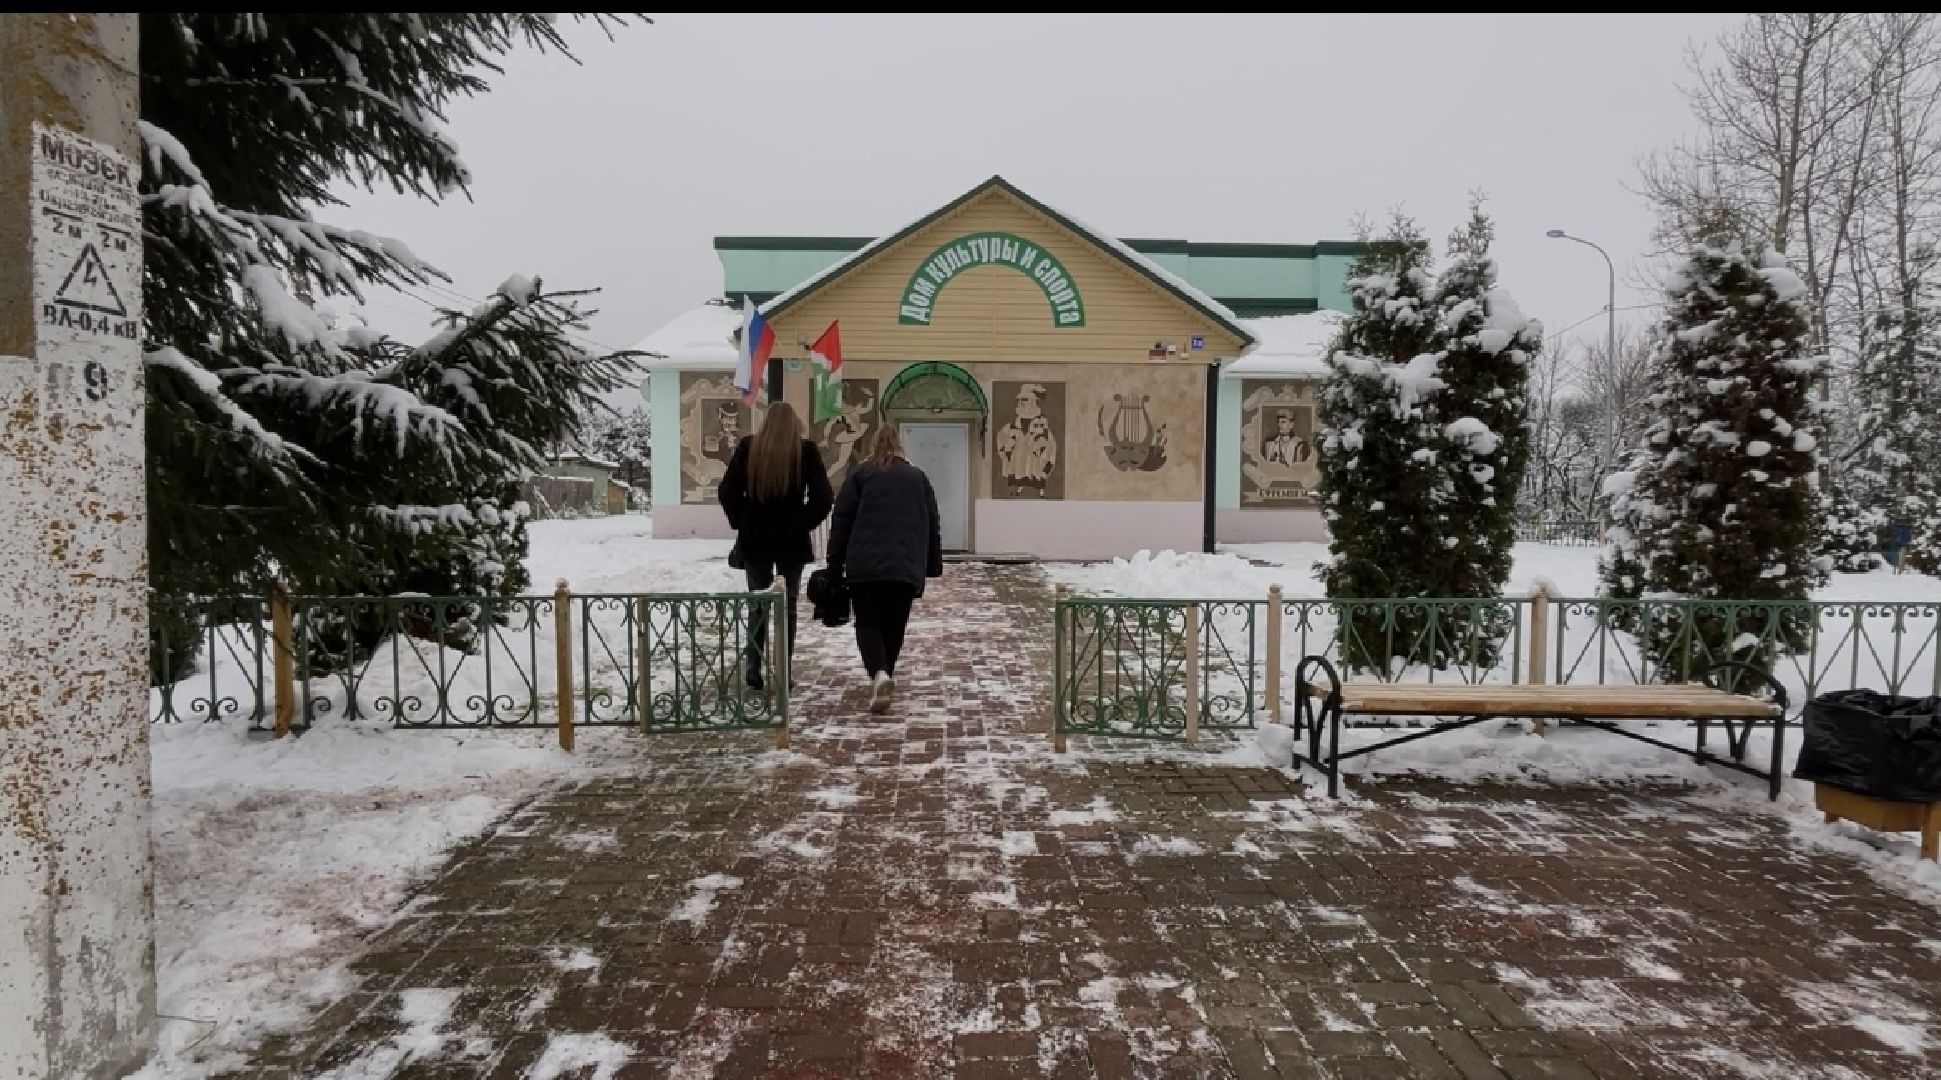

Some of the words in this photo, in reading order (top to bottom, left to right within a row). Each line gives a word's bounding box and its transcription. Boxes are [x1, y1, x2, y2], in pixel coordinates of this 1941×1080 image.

[53, 216, 63, 233] 2
[101, 231, 111, 248] 2
[901, 277, 936, 322] Дом
[925, 237, 1020, 283] культуры
[1020, 247, 1037, 269] и
[1034, 257, 1080, 324] спорта
[84, 361, 108, 401] 9
